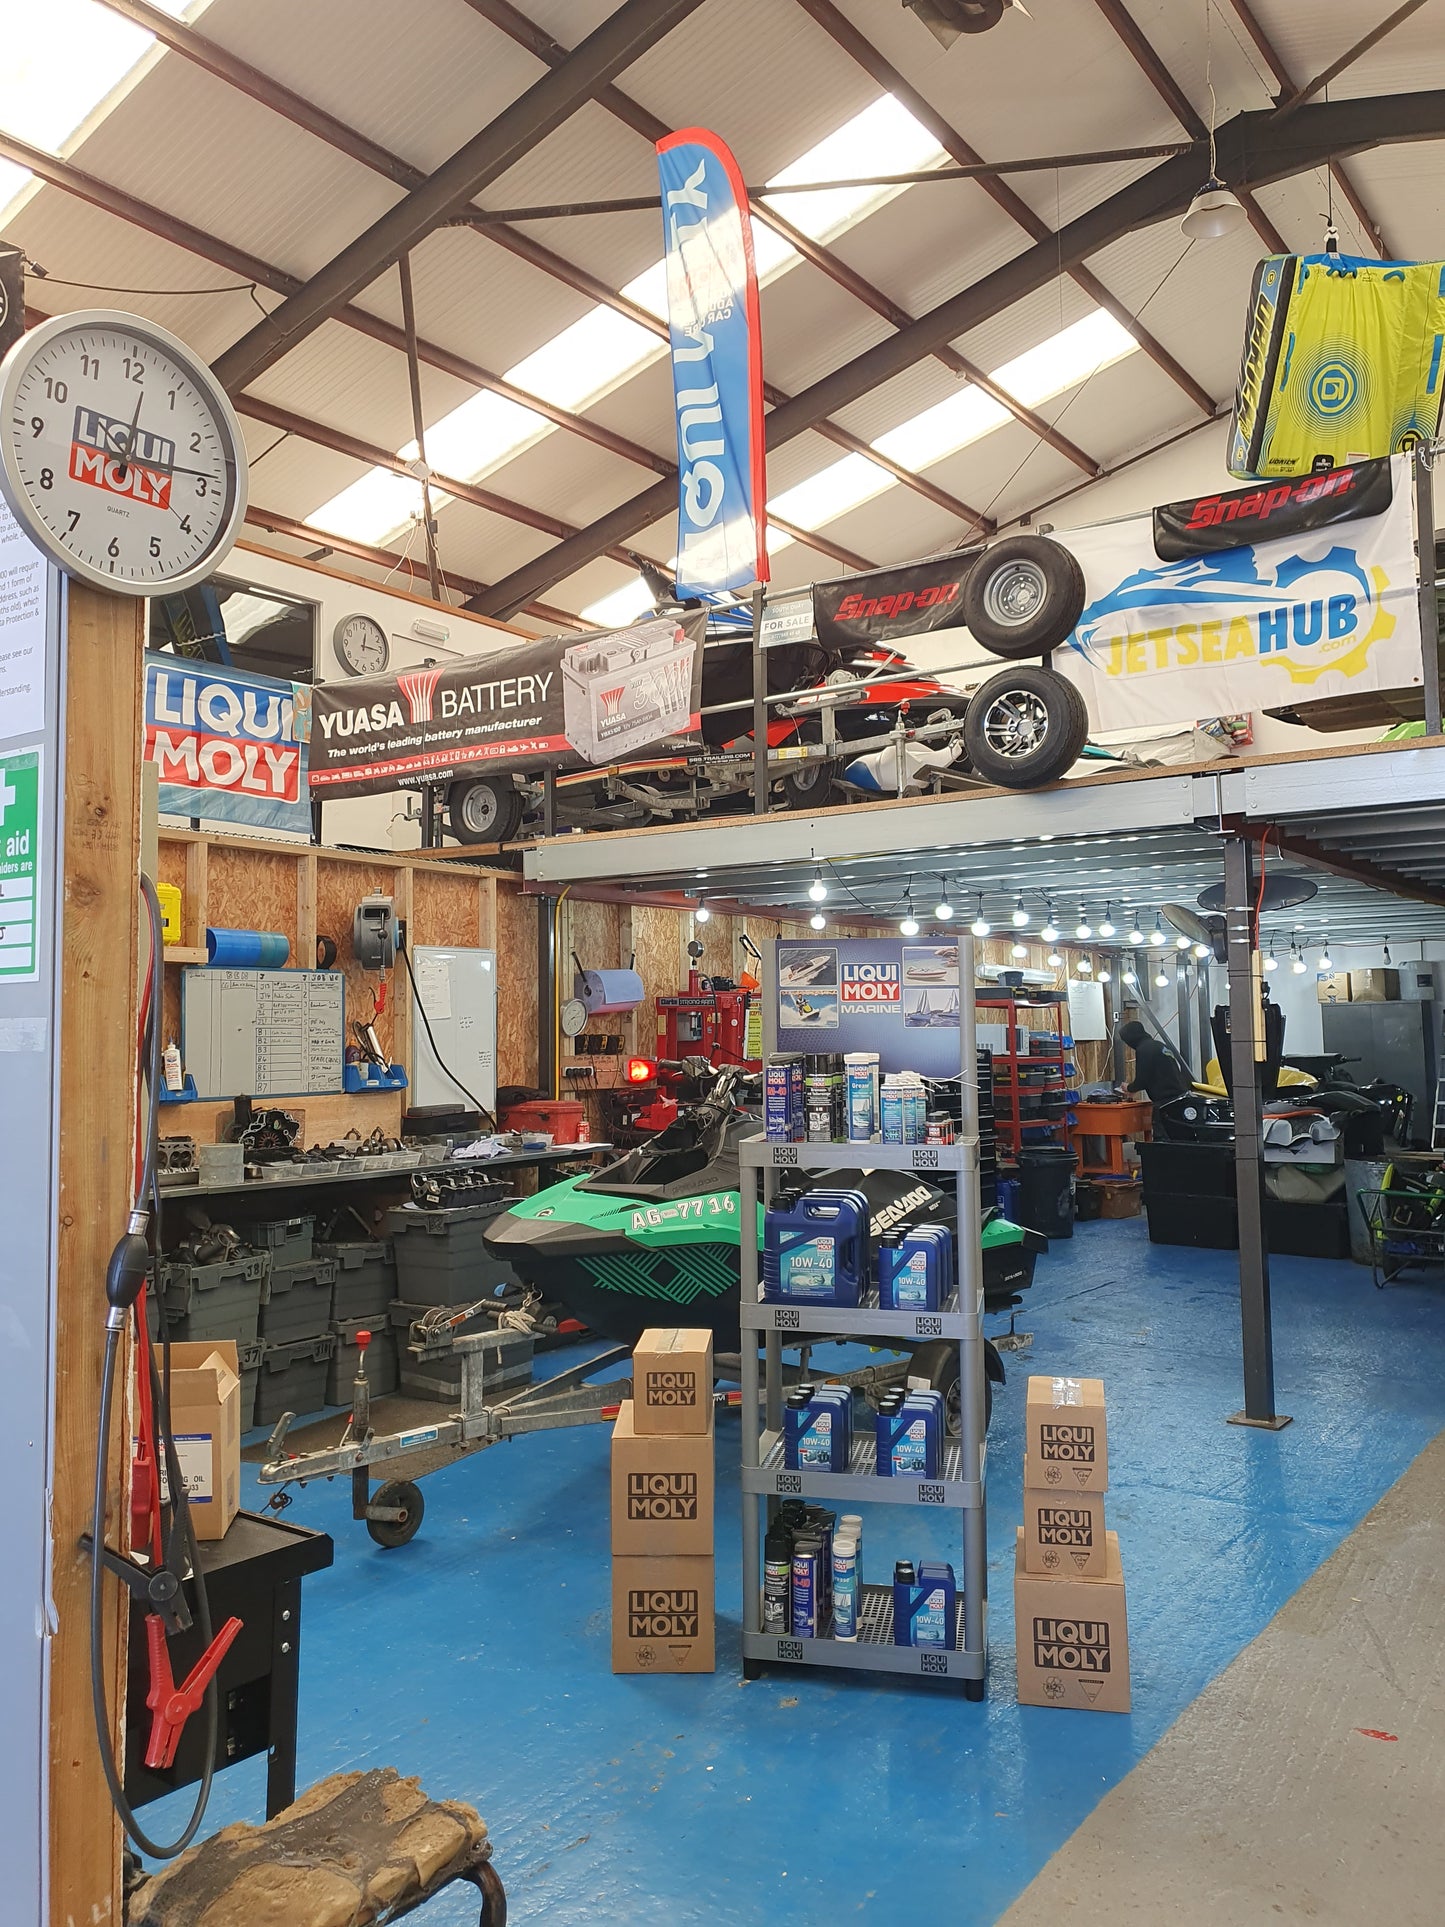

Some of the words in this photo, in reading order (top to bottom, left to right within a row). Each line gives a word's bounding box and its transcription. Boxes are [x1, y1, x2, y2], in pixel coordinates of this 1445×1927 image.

[80, 354, 100, 380] 11
[122, 358, 145, 385] 12
[44, 377, 68, 404] 10
[168, 390, 176, 410] 1
[31, 416, 44, 438] 9
[78, 410, 171, 466] LIQUI
[189, 432, 202, 454] 2
[40, 468, 54, 490] 8
[75, 446, 170, 504] MOLY
[195, 477, 208, 498] 3
[1185, 469, 1354, 530] Snap-on
[106, 506, 130, 518] QUARTZ
[68, 510, 81, 532] 7
[180, 514, 192, 534] 4
[108, 537, 120, 558] 6
[149, 537, 162, 558] 5
[19, 561, 39, 574] require
[12, 578, 25, 588] form
[19, 587, 32, 597] such
[23, 597, 39, 608] which
[832, 582, 960, 622] Snap-on
[6, 610, 34, 625] Protection
[35, 608, 39, 616] &
[764, 620, 783, 631] FOR
[786, 616, 809, 627] SALE
[154, 672, 293, 742] LIQUI
[318, 700, 404, 739] YUASA
[441, 671, 554, 719] BATTERY
[600, 712, 627, 728] YUASA
[328, 747, 347, 759] The
[348, 742, 386, 756] world's
[387, 736, 423, 750] leading
[424, 728, 463, 744] battery
[464, 716, 542, 736] manufacturer
[152, 730, 298, 794] MOLY
[398, 769, 454, 787] www.yuasa.com
[6, 829, 29, 857] aid
[20, 861, 32, 872] are
[844, 965, 897, 982] LIQUI
[844, 983, 898, 999] MOLY
[841, 1004, 900, 1014] MARINE
[246, 1262, 260, 1276] J8
[790, 1256, 832, 1269] 10W-40
[898, 1277, 926, 1286] 10W-40
[776, 1312, 798, 1320] LIQUI
[776, 1319, 799, 1327] MOLY
[917, 1318, 941, 1327] LIQUI
[916, 1327, 942, 1335] MOLY
[244, 1349, 258, 1362] J7
[649, 1373, 694, 1389] LIQUI
[649, 1390, 695, 1405] MOLY
[803, 1438, 830, 1446] 10W-40
[1042, 1426, 1093, 1442] LIQUI
[896, 1445, 925, 1453] 10W-40
[1042, 1443, 1094, 1460] MOLY
[630, 1474, 693, 1497] LIQUI
[777, 1476, 801, 1484] LIQUI
[777, 1484, 801, 1492] MOLY
[920, 1485, 944, 1494] LIQUI
[920, 1494, 944, 1502] MOLY
[631, 1498, 696, 1519] MOLY
[1040, 1510, 1089, 1527] LIQUI
[1041, 1528, 1090, 1544] MOLY
[631, 1592, 695, 1614] LIQUI
[631, 1615, 697, 1636] MOLY
[916, 1615, 944, 1624] 10W-40
[1037, 1619, 1108, 1645] LIQUI
[779, 1642, 802, 1650] LIQUI
[779, 1650, 802, 1659] MOLY
[922, 1655, 947, 1664] LIQUI
[1037, 1645, 1110, 1671] MOLY
[922, 1664, 947, 1673] MOLY
